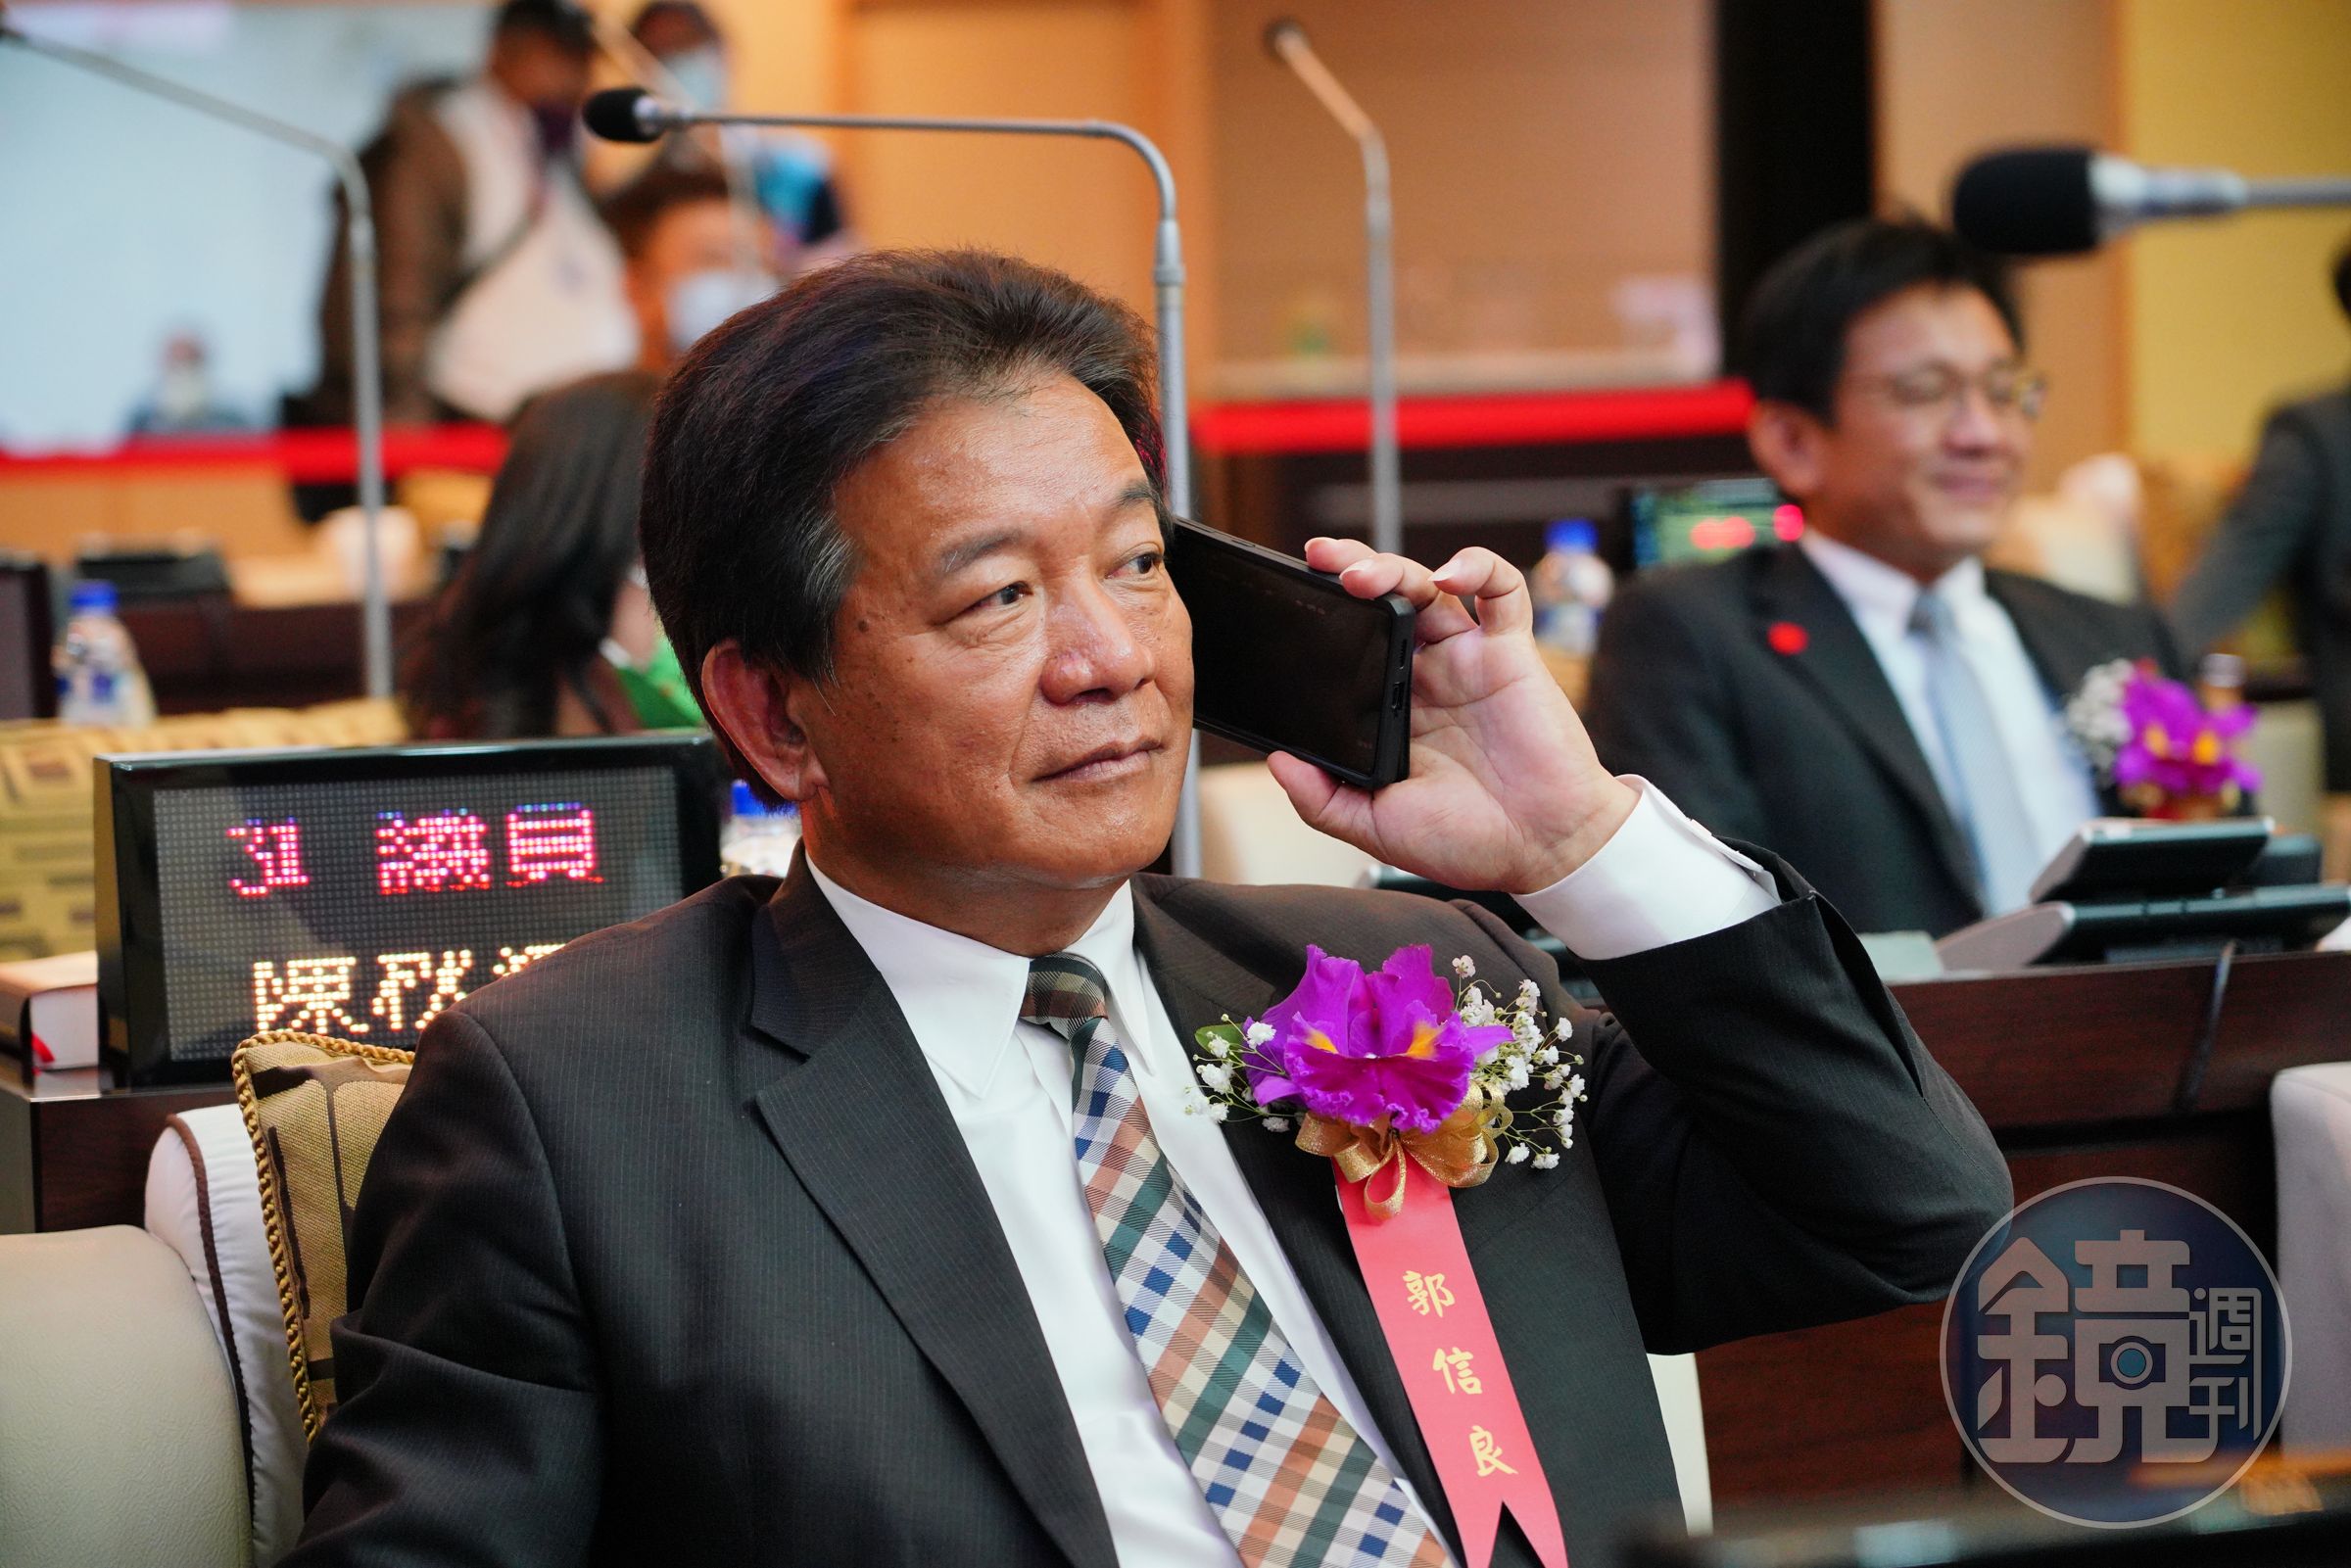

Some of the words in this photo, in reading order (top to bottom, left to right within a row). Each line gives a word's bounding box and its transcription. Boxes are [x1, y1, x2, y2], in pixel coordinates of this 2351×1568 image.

[375, 800, 604, 896] 議員
[252, 945, 566, 1035] 陳秋
[1402, 1270, 1518, 1478] 郭信良
